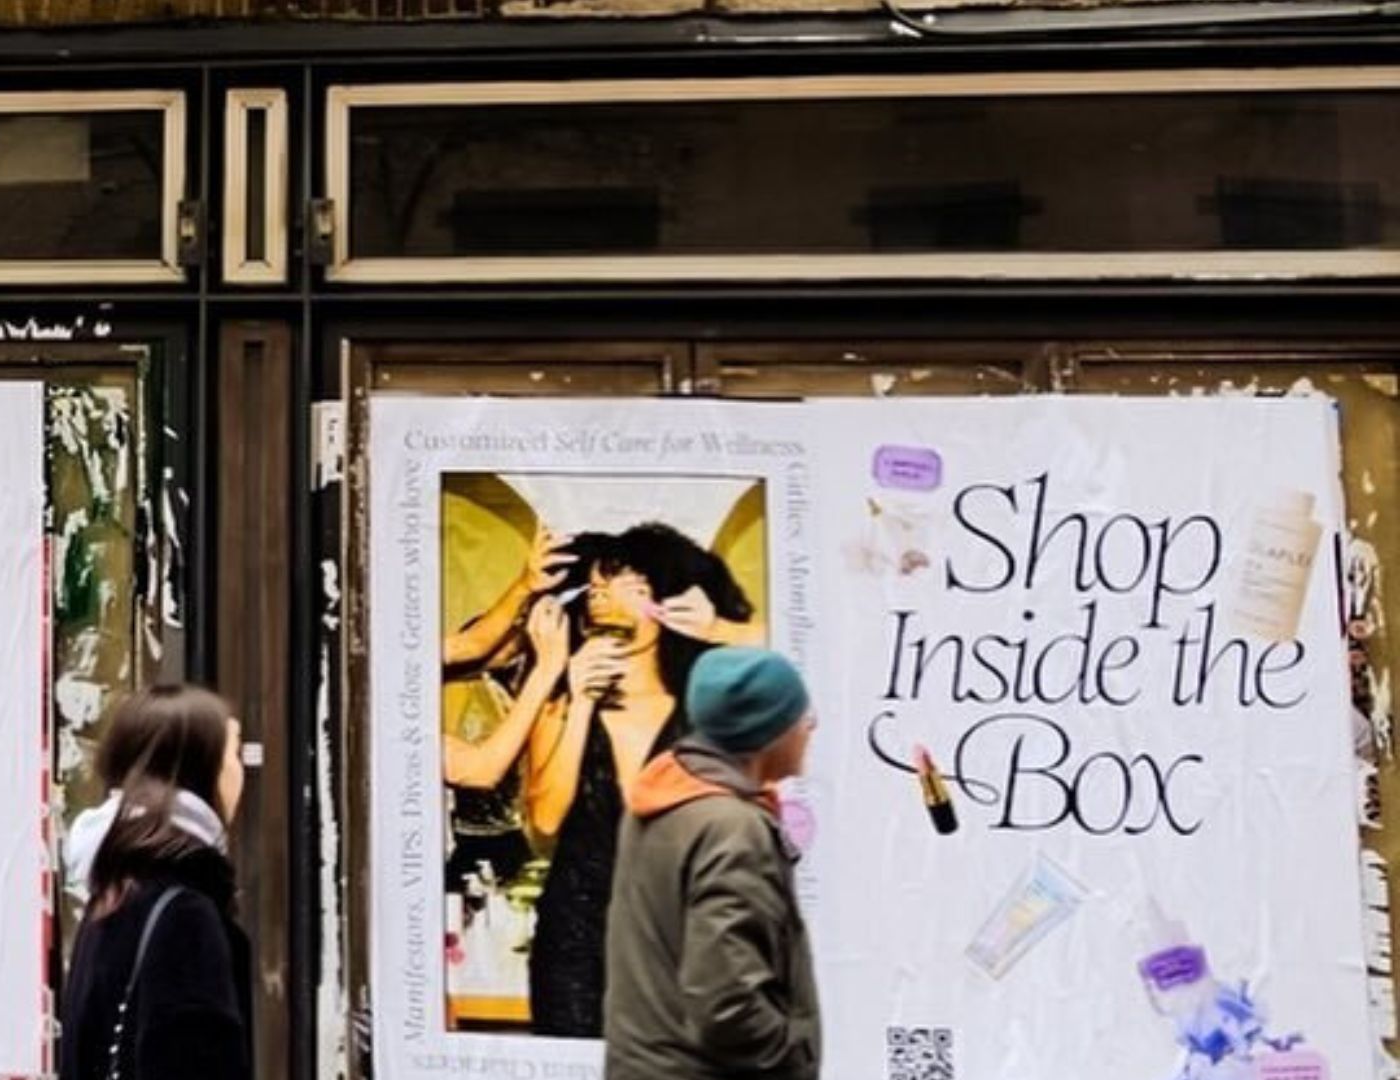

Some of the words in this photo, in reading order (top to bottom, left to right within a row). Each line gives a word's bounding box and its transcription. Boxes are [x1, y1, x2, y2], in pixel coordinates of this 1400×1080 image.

[553, 429, 598, 457] Self
[600, 430, 655, 453] Care
[397, 458, 420, 508] love
[396, 514, 420, 567] who
[946, 471, 1222, 629] Shop
[883, 600, 1141, 707] Inside
[1172, 601, 1308, 709] the
[400, 727, 422, 746] &
[868, 711, 1204, 836] Box
